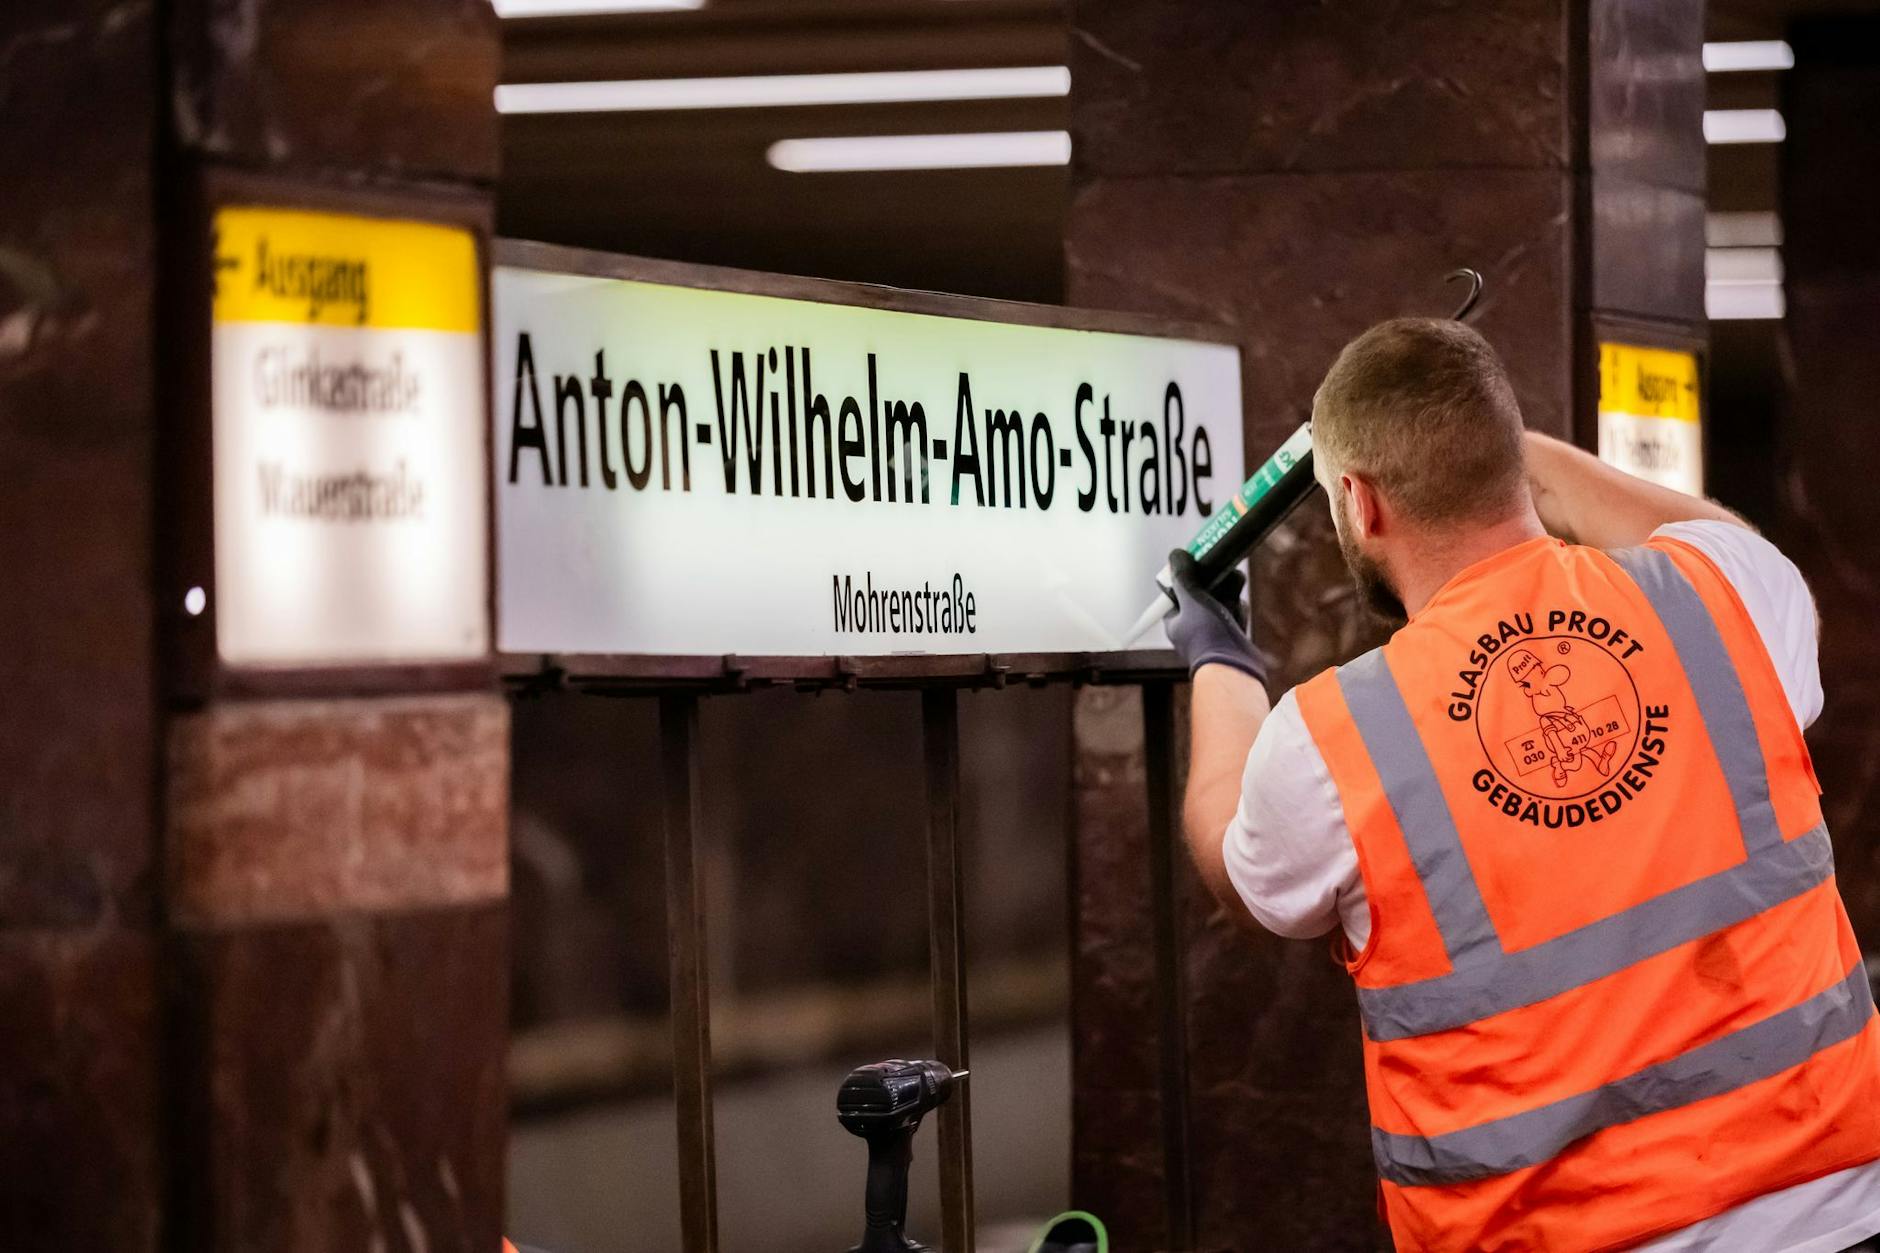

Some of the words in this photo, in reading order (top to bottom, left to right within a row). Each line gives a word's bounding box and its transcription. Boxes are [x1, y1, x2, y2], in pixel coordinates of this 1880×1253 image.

[509, 332, 1213, 517] Anton-Wilhelm-Amo-Straße
[834, 572, 976, 634] Mohrenstraße
[1448, 613, 1534, 722] GLASBAU
[1549, 611, 1644, 659] PROFT
[1472, 704, 1670, 829] GEBÄUDEDIENSTE
[1523, 750, 1546, 766] 030
[1571, 734, 1588, 747] 411
[1591, 726, 1605, 739] 10
[1606, 720, 1620, 734] 28
